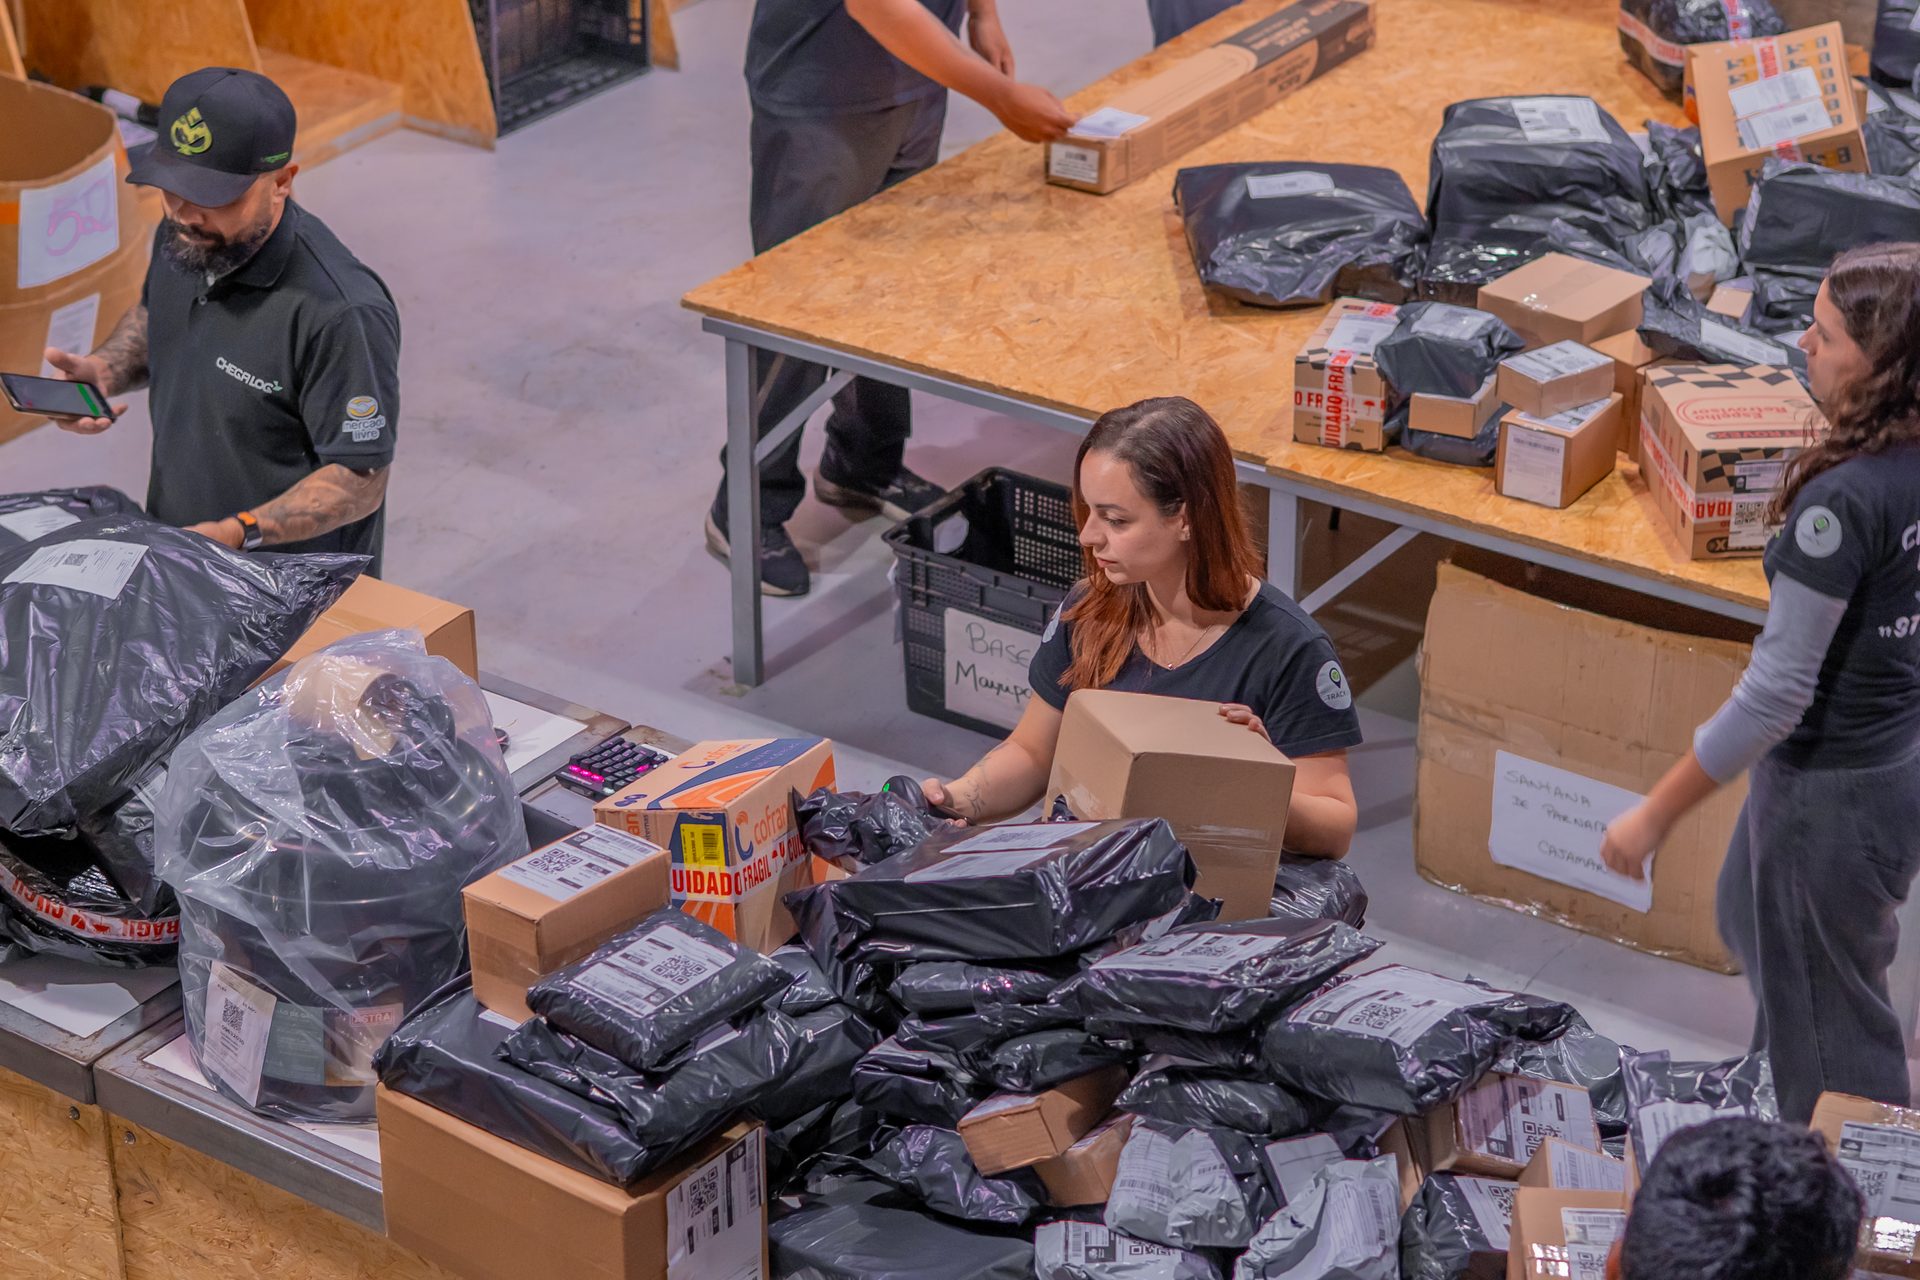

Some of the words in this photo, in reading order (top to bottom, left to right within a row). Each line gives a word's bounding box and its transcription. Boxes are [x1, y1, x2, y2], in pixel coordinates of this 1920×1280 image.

[1324, 394, 1343, 448] UIDADO
[965, 622, 1031, 668] BASE
[672, 868, 743, 897] UIDADO
[743, 854, 772, 892] FRÁGIL
